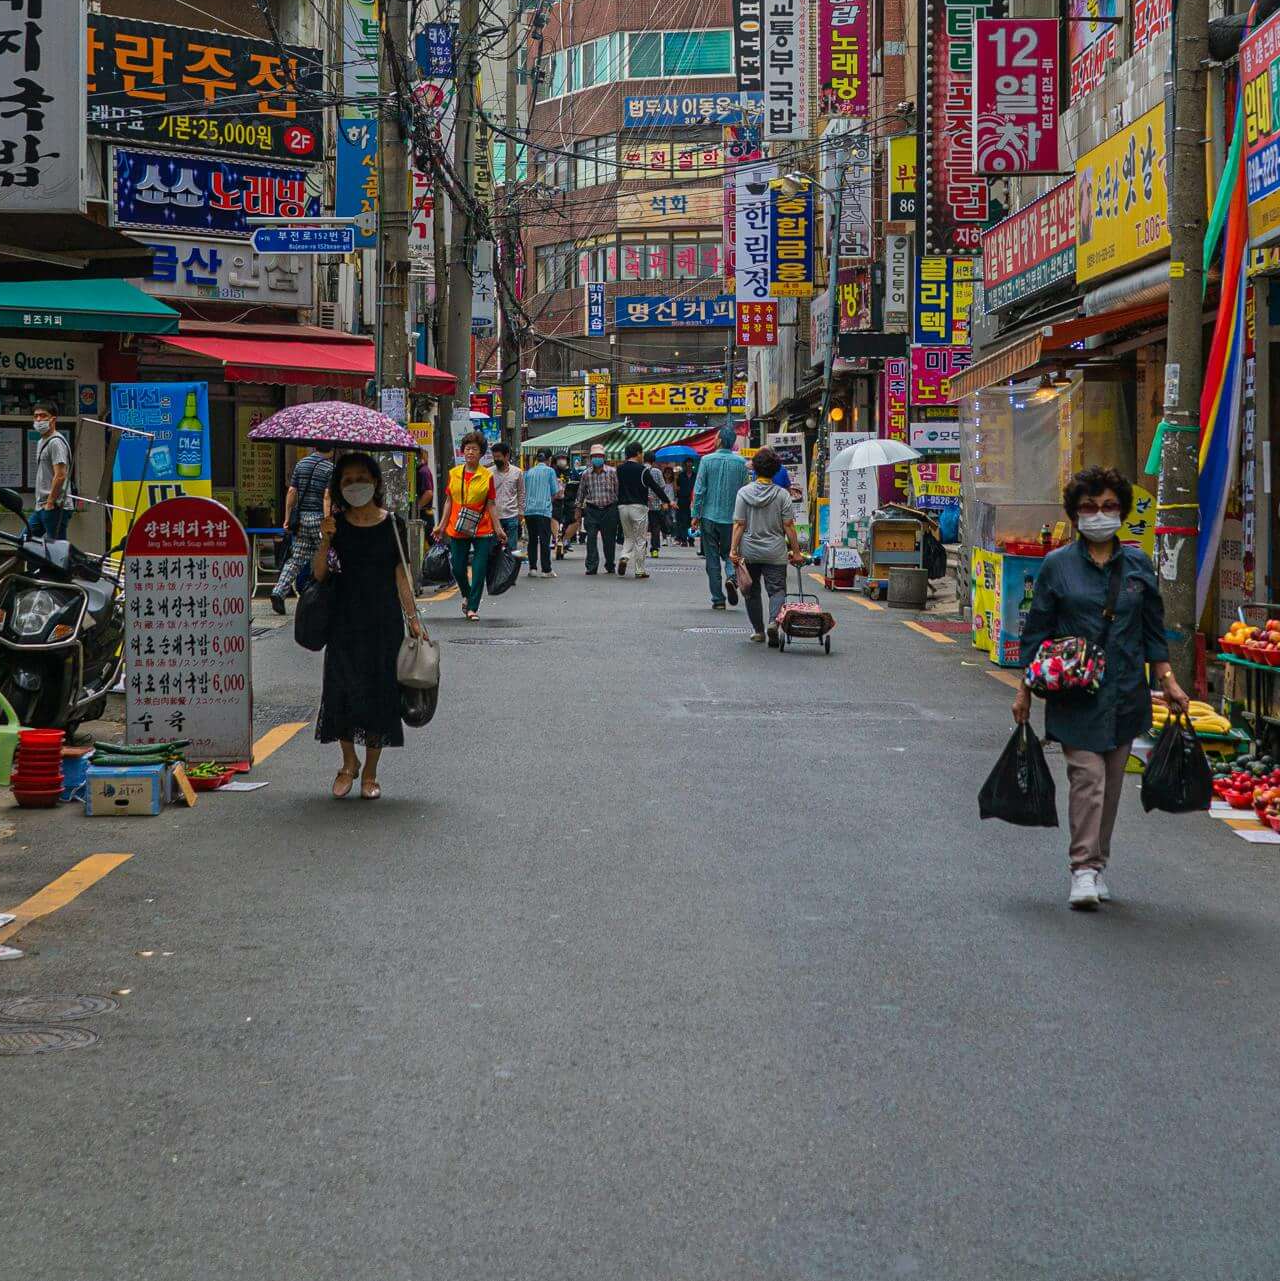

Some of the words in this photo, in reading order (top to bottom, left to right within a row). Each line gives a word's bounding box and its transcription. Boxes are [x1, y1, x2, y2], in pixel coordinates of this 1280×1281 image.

[740, 1, 762, 85] HOTEL
[989, 27, 1038, 68] 12
[831, 30, 861, 100] 노래방
[158, 114, 273, 150] 기본:25,000원
[995, 74, 1042, 163] 열차
[210, 171, 309, 219] 노래방
[899, 198, 916, 213] 86
[743, 200, 771, 298] 한림정
[14, 350, 75, 372] Queen's
[212, 560, 244, 580] 6,000
[212, 597, 244, 617] 6,000
[212, 635, 245, 657] 6,000
[212, 673, 245, 695] 6,000
